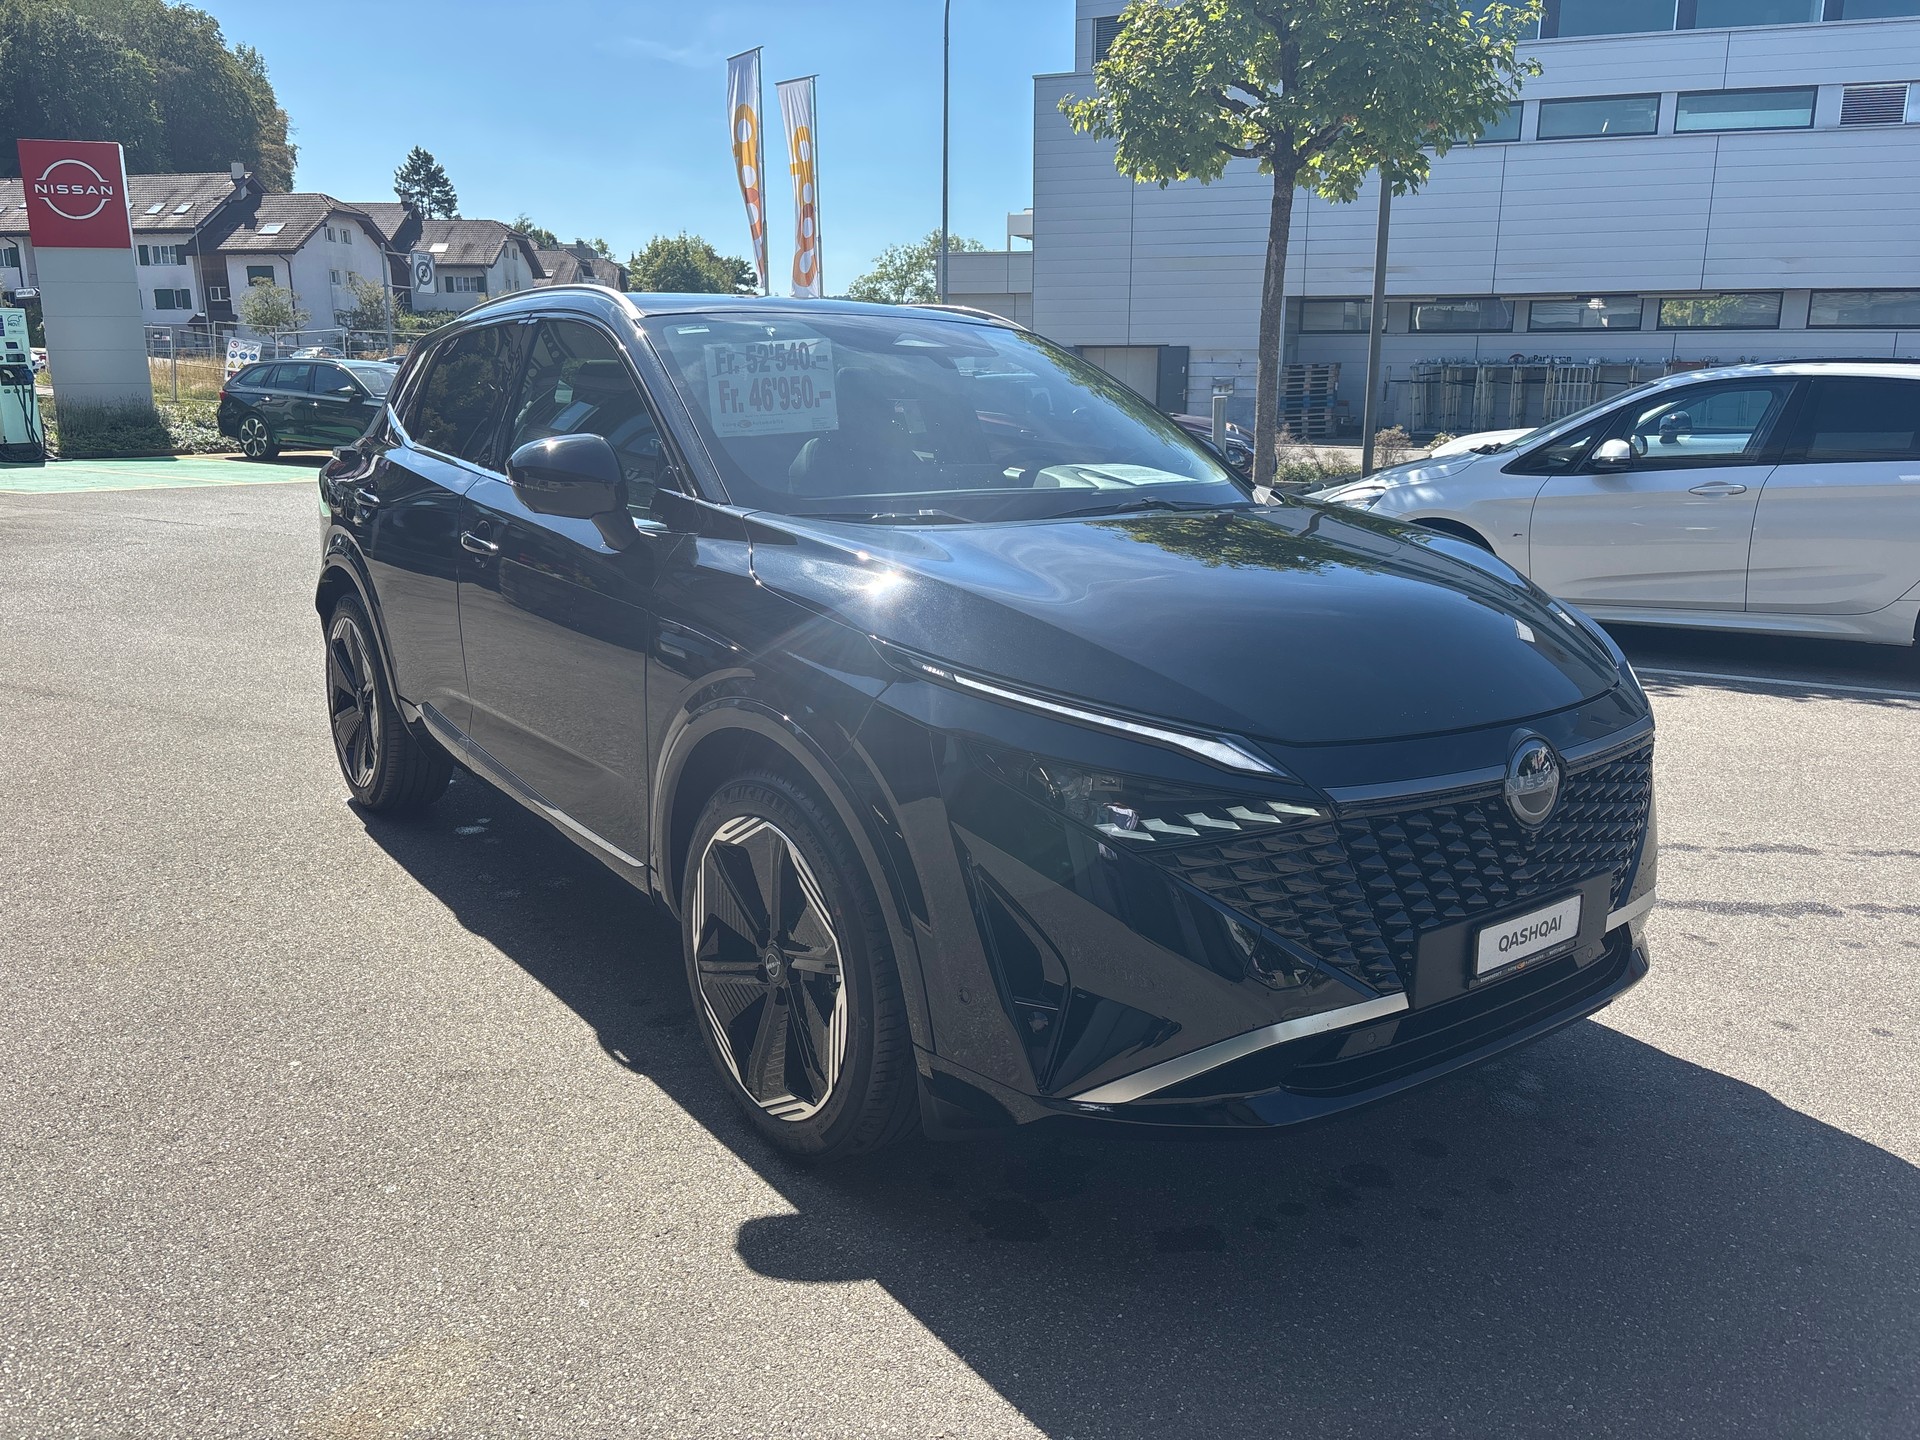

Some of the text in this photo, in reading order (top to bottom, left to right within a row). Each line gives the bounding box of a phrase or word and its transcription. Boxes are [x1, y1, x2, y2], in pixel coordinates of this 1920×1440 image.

[34, 182, 114, 196] NISSAN
[714, 346, 740, 375] Fr.
[717, 376, 831, 413] Fr. 46'950.-
[1507, 768, 1559, 793] NISSAN
[730, 784, 798, 820] MICHELIN
[1498, 914, 1563, 953] QASHQAI
